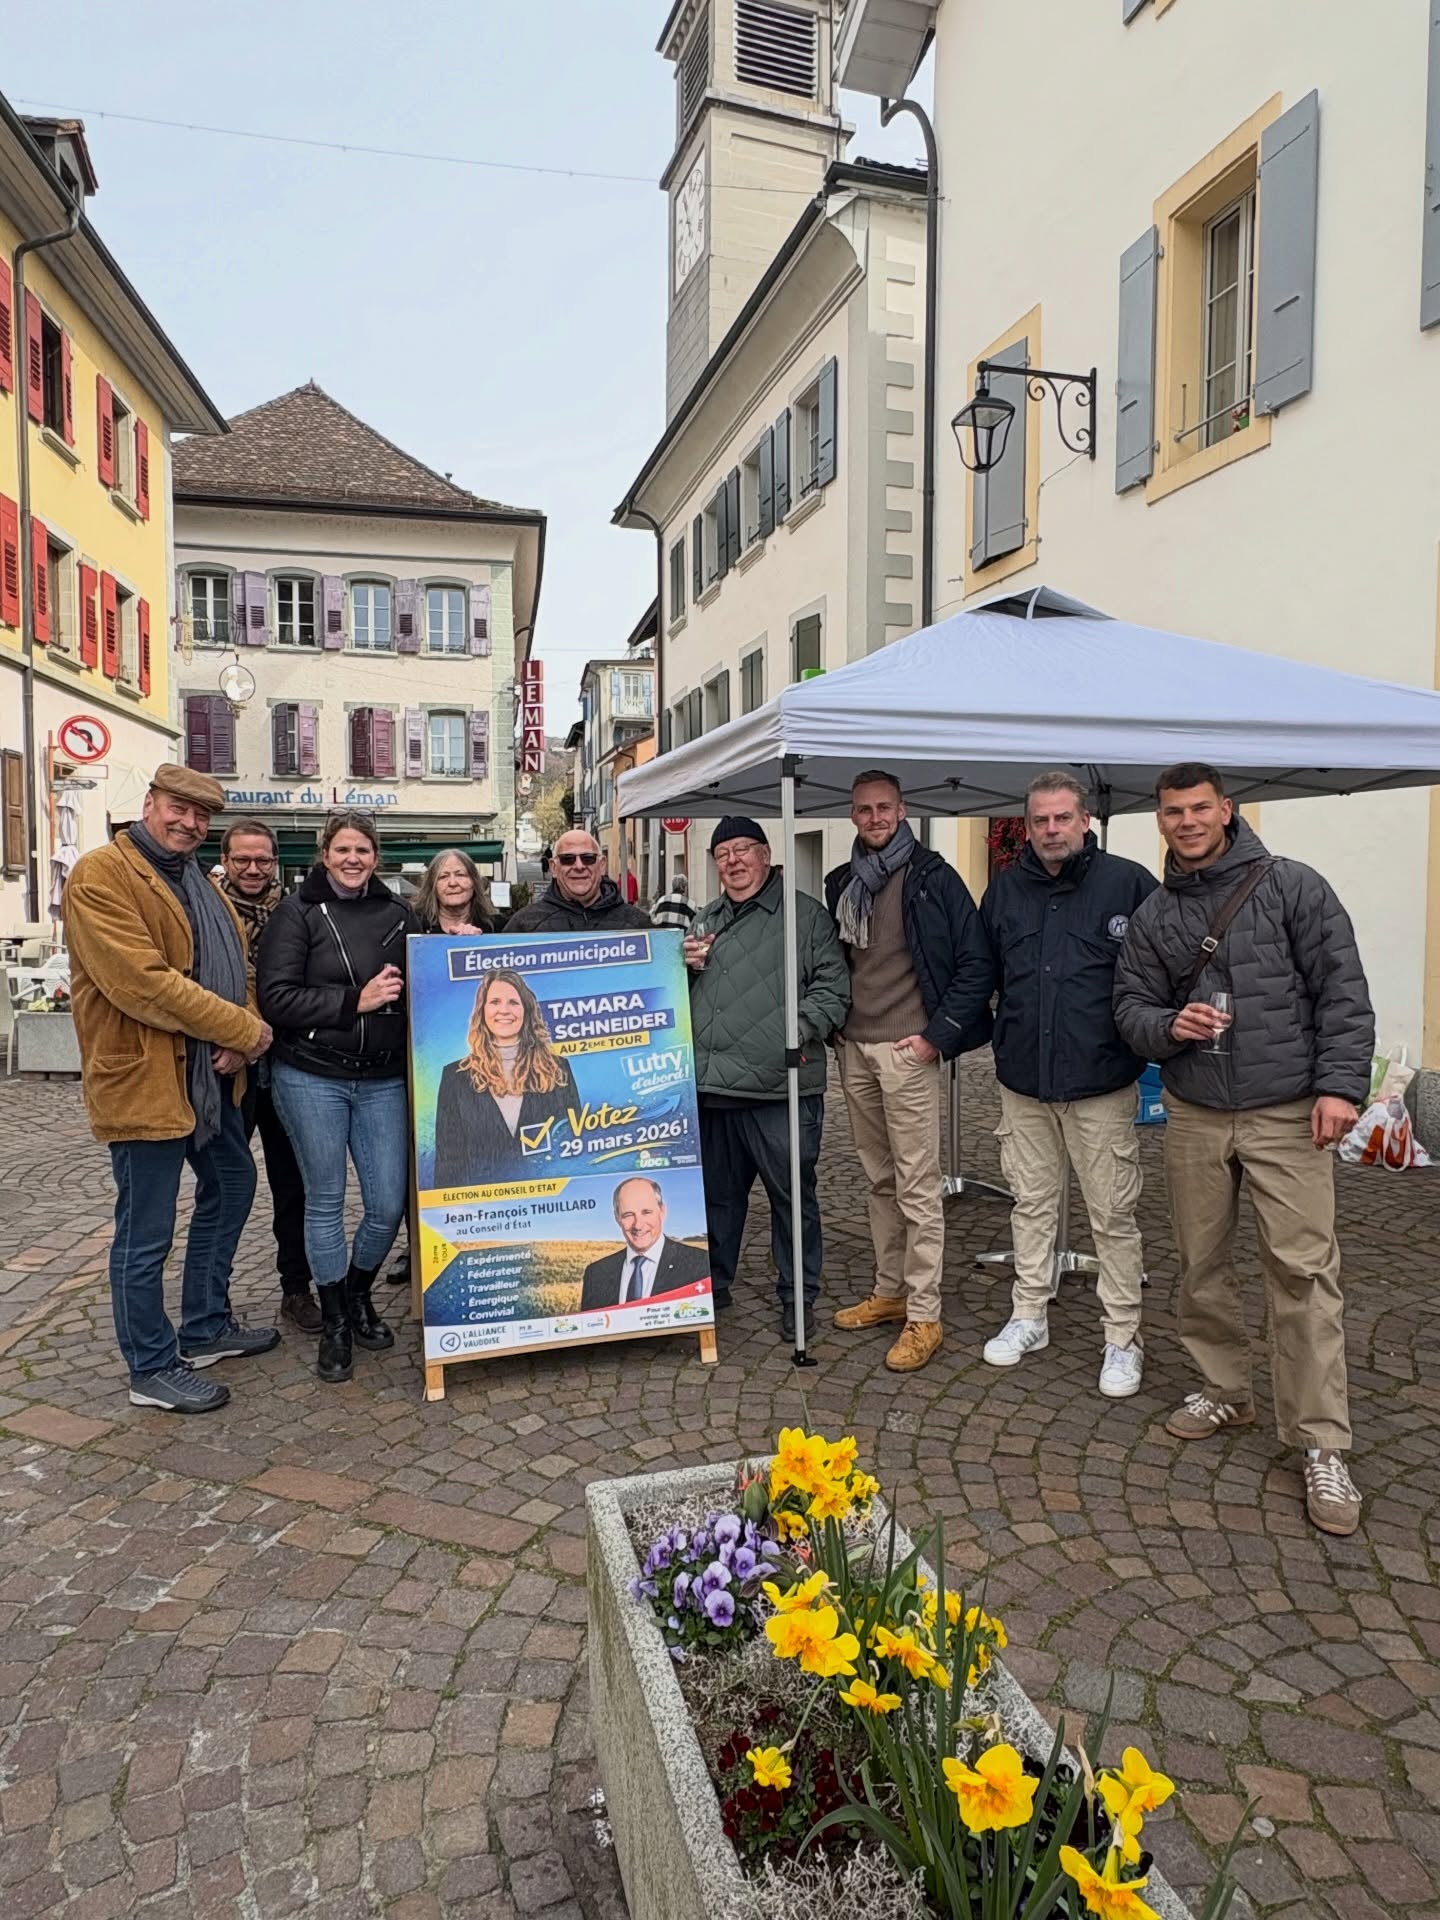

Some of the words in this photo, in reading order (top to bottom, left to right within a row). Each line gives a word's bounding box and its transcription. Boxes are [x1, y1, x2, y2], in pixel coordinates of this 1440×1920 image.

[524, 661, 540, 772] LEMAN
[224, 788, 293, 805] taurant
[300, 786, 323, 804] du
[333, 786, 398, 808] Léman
[464, 951, 537, 972] Élection
[540, 940, 637, 964] municipale
[547, 993, 646, 1020] TAMARA
[554, 1011, 668, 1040] SCHNEIDER
[560, 1043, 577, 1054] AU
[608, 1034, 643, 1047] TOUR
[627, 1050, 683, 1078] Lutry
[567, 1102, 638, 1137] Votez
[560, 1138, 583, 1158] 29
[587, 1132, 633, 1153] mars
[443, 1191, 480, 1202] ÉLECTION
[480, 1190, 492, 1198] AU
[493, 1185, 528, 1197] CONSEIL
[444, 1204, 528, 1225] Jean-François
[530, 1199, 597, 1215] THUILLARD
[456, 1228, 468, 1236] au
[469, 1221, 502, 1235] Conseil
[504, 1219, 532, 1231] d'État
[466, 1249, 531, 1267] Expérimenté
[467, 1266, 523, 1280] Fédérateur
[468, 1280, 520, 1294] Travailleur
[468, 1294, 520, 1308] Énergique
[468, 1306, 515, 1321] Convivial
[679, 1308, 703, 1318] UDC
[462, 1326, 507, 1339] L'ALLIANCE
[463, 1336, 501, 1349] VAUDOISE
